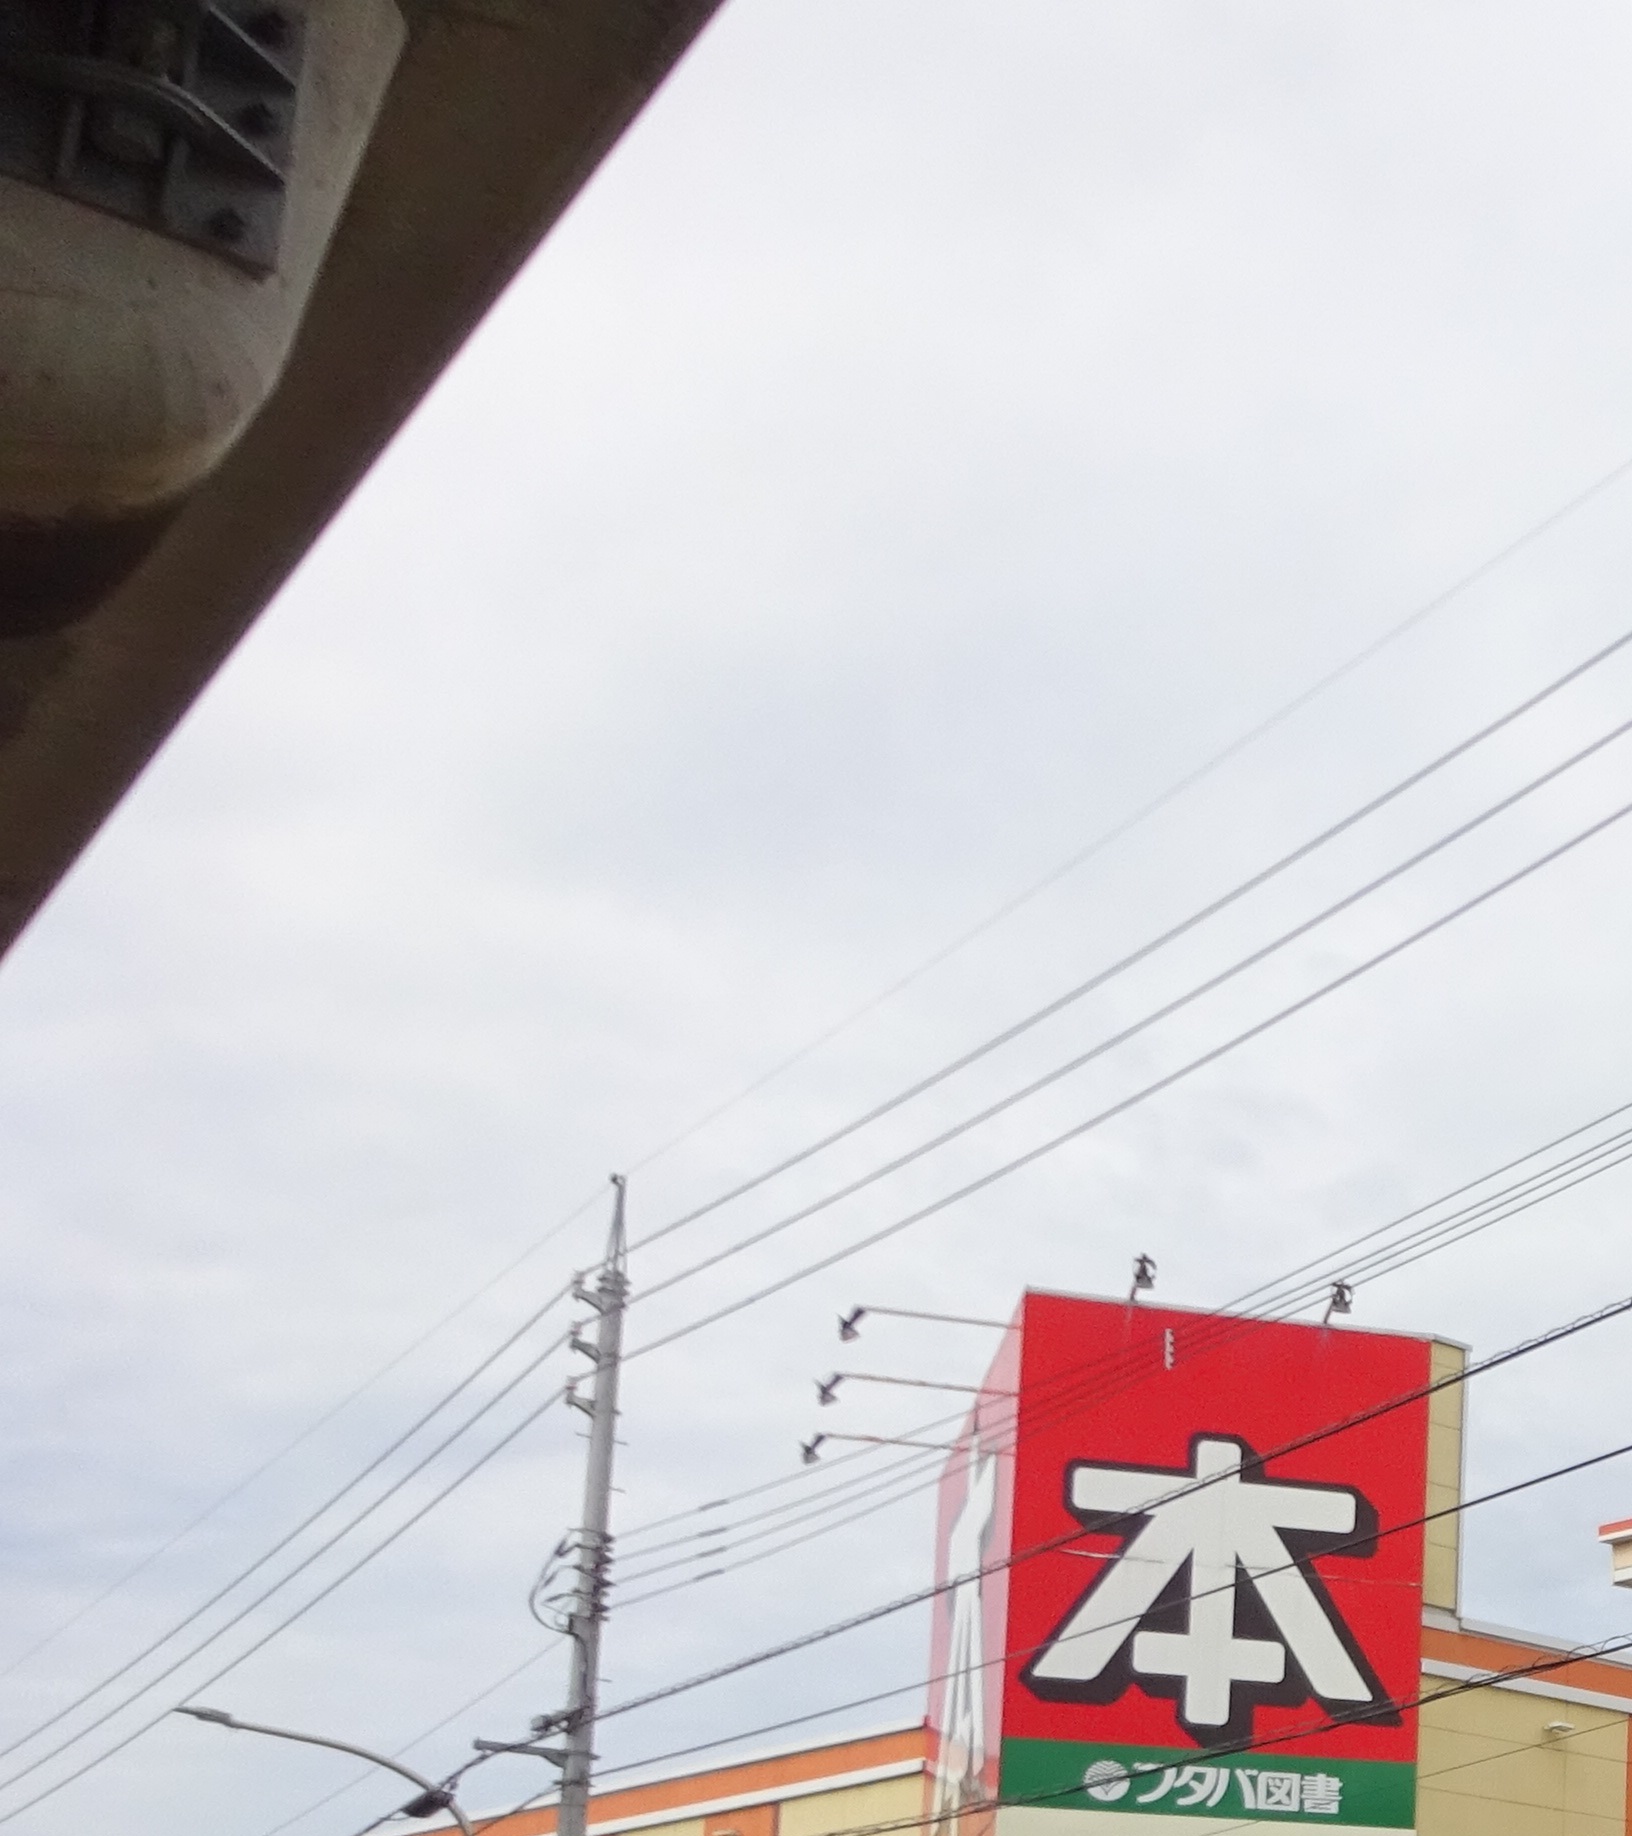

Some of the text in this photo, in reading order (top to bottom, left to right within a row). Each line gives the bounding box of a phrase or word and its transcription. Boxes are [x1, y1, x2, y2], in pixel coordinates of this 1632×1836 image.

[1020, 1434, 1402, 1746] 本
[1133, 1762, 1342, 1814] フタバ図書
